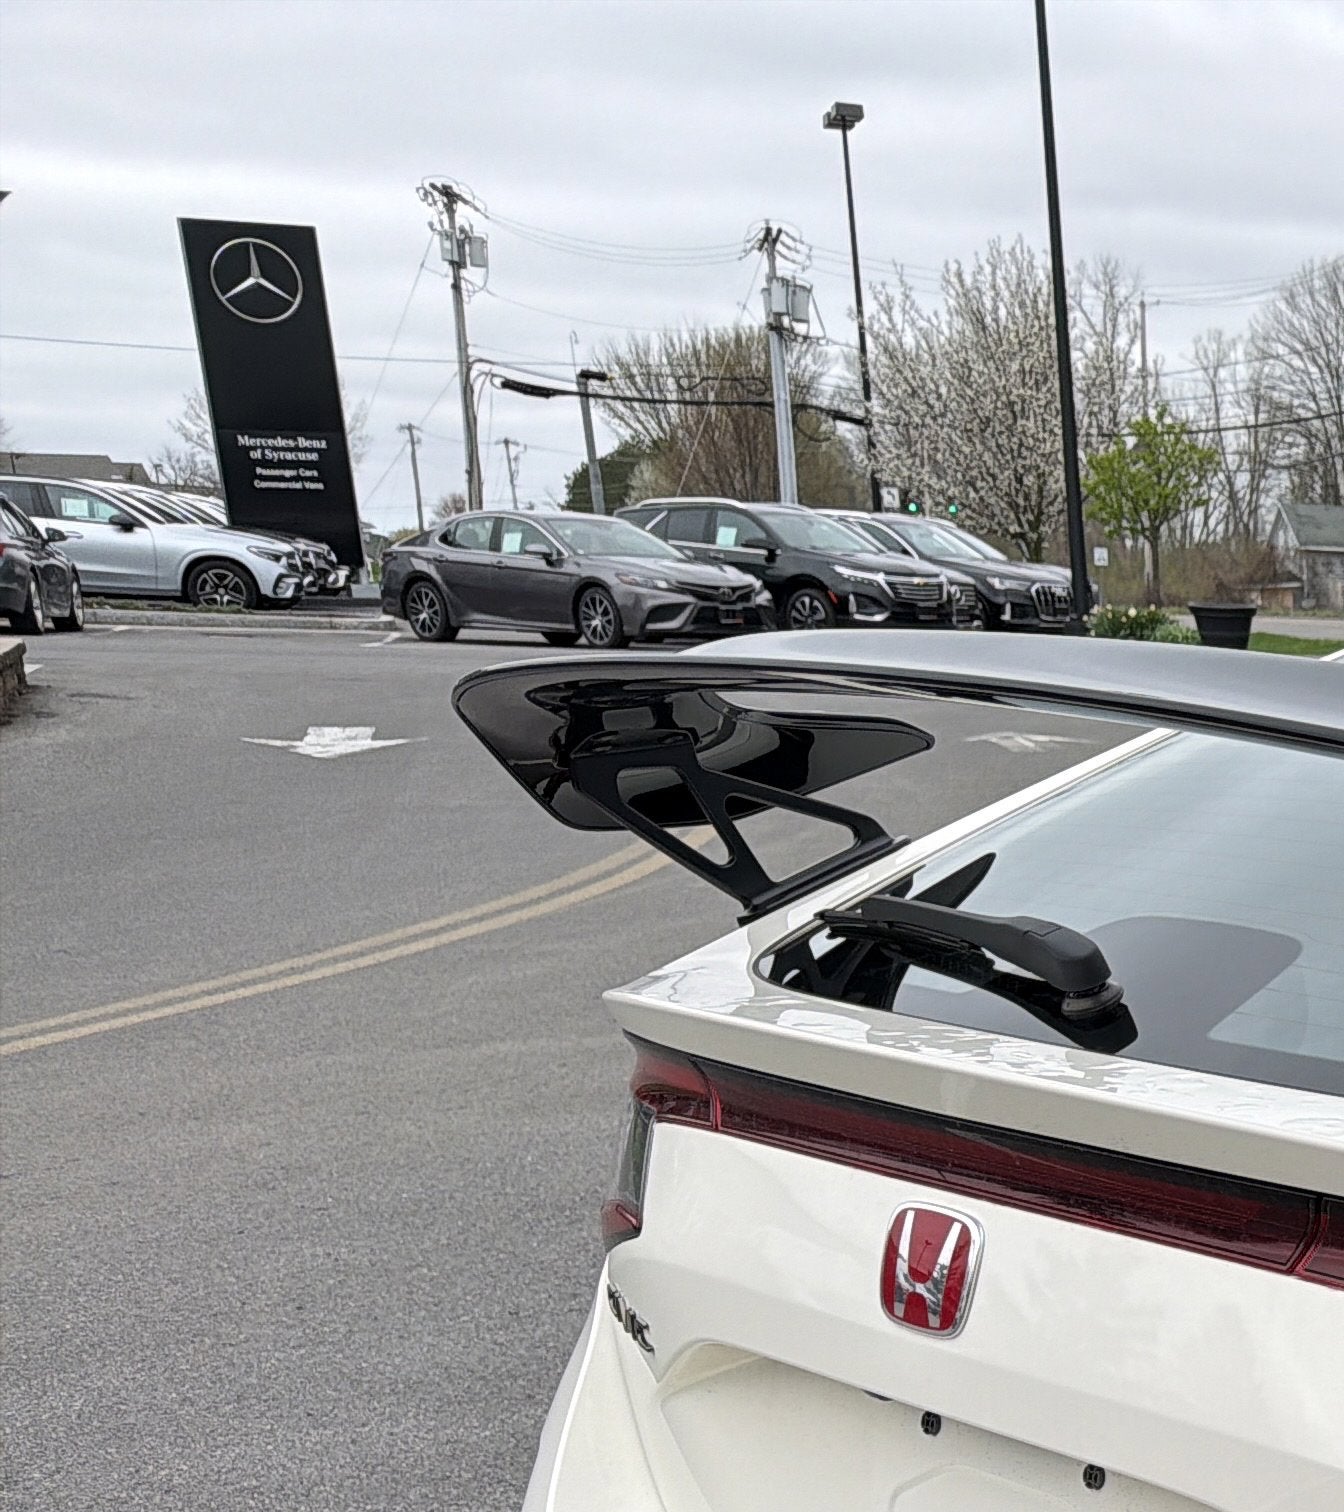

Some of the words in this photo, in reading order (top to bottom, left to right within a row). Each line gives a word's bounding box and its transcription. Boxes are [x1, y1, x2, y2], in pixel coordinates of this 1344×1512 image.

[236, 434, 328, 449] Mercedes-Benz
[249, 448, 262, 460] of
[264, 448, 319, 462] Syracuse
